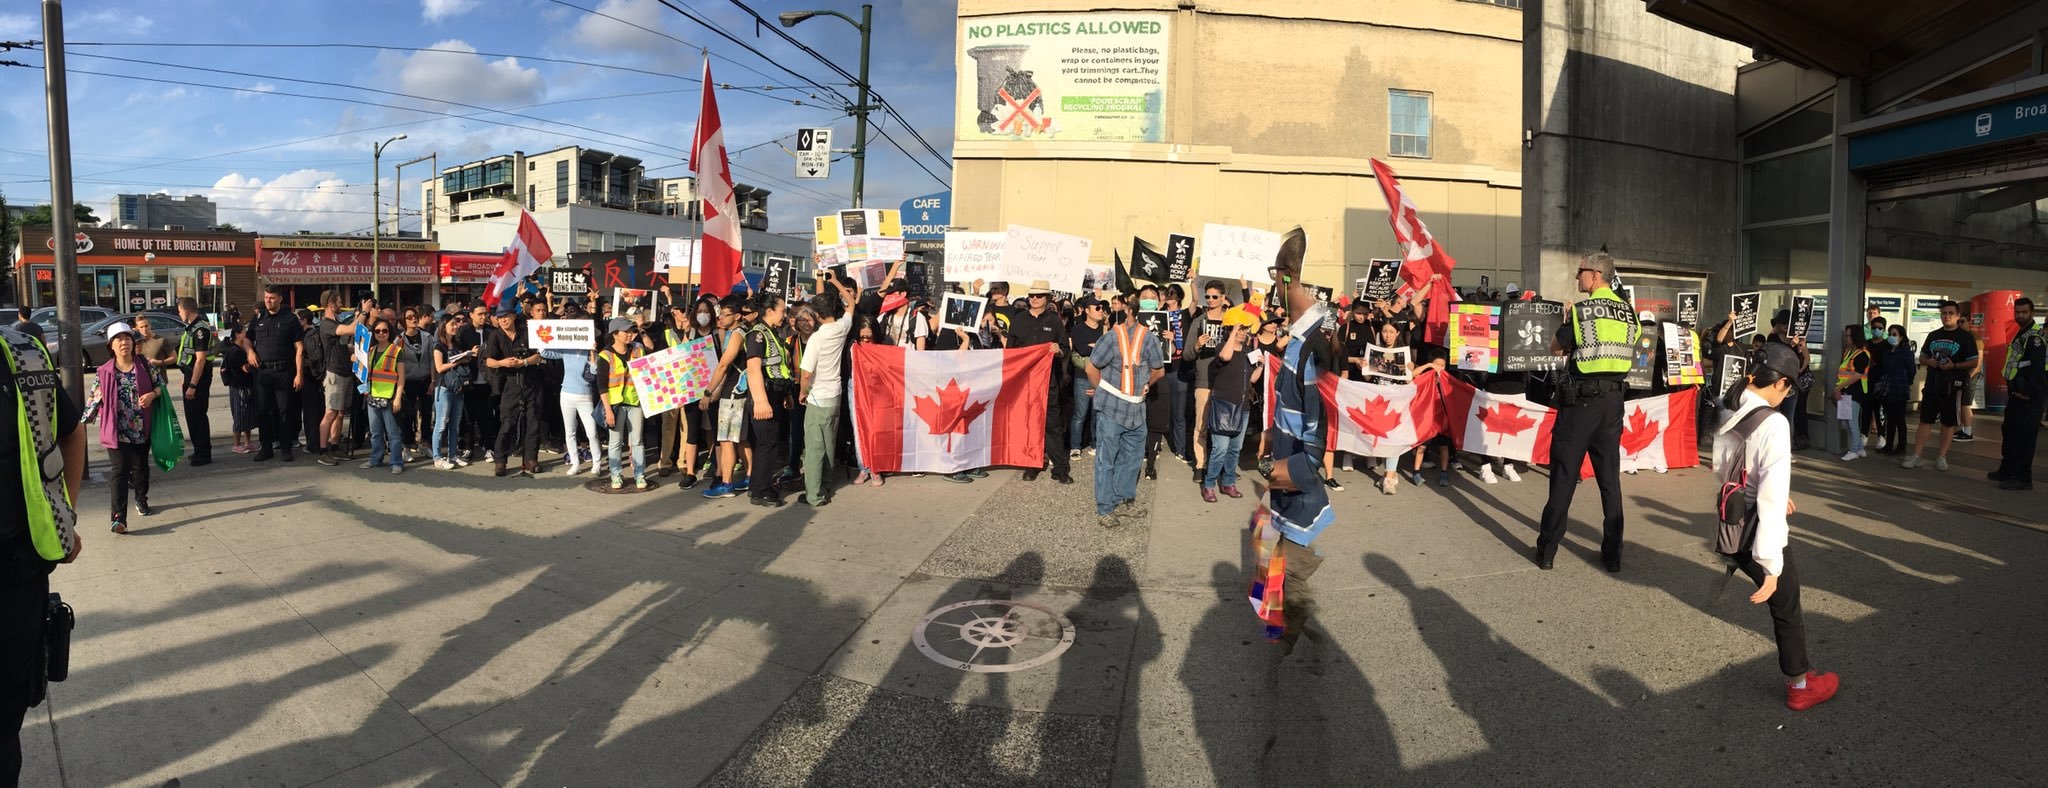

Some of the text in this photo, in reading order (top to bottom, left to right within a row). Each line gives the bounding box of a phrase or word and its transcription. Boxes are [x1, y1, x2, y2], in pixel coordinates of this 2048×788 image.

[969, 21, 1161, 39] NO PLASTICS ALLOWED
[1139, 46, 1160, 55] bags,
[2016, 104, 2047, 119] Broa
[913, 199, 940, 208] CAFE
[922, 211, 929, 221] &
[902, 225, 950, 234] PRODUCE
[114, 238, 236, 251] HOME OF THE BURGER FAMILY
[306, 265, 344, 273] EXTREME
[347, 265, 358, 273] XE
[380, 266, 432, 274] RESTAURANT
[553, 272, 573, 283] FREE
[553, 284, 586, 292] HONG KONG
[1530, 302, 1564, 314] FREEDOM
[1582, 299, 1630, 311] VANCOUVER
[1582, 306, 1634, 324] POLICE
[1206, 323, 1223, 338] FREE
[18, 374, 54, 388] POLICE
